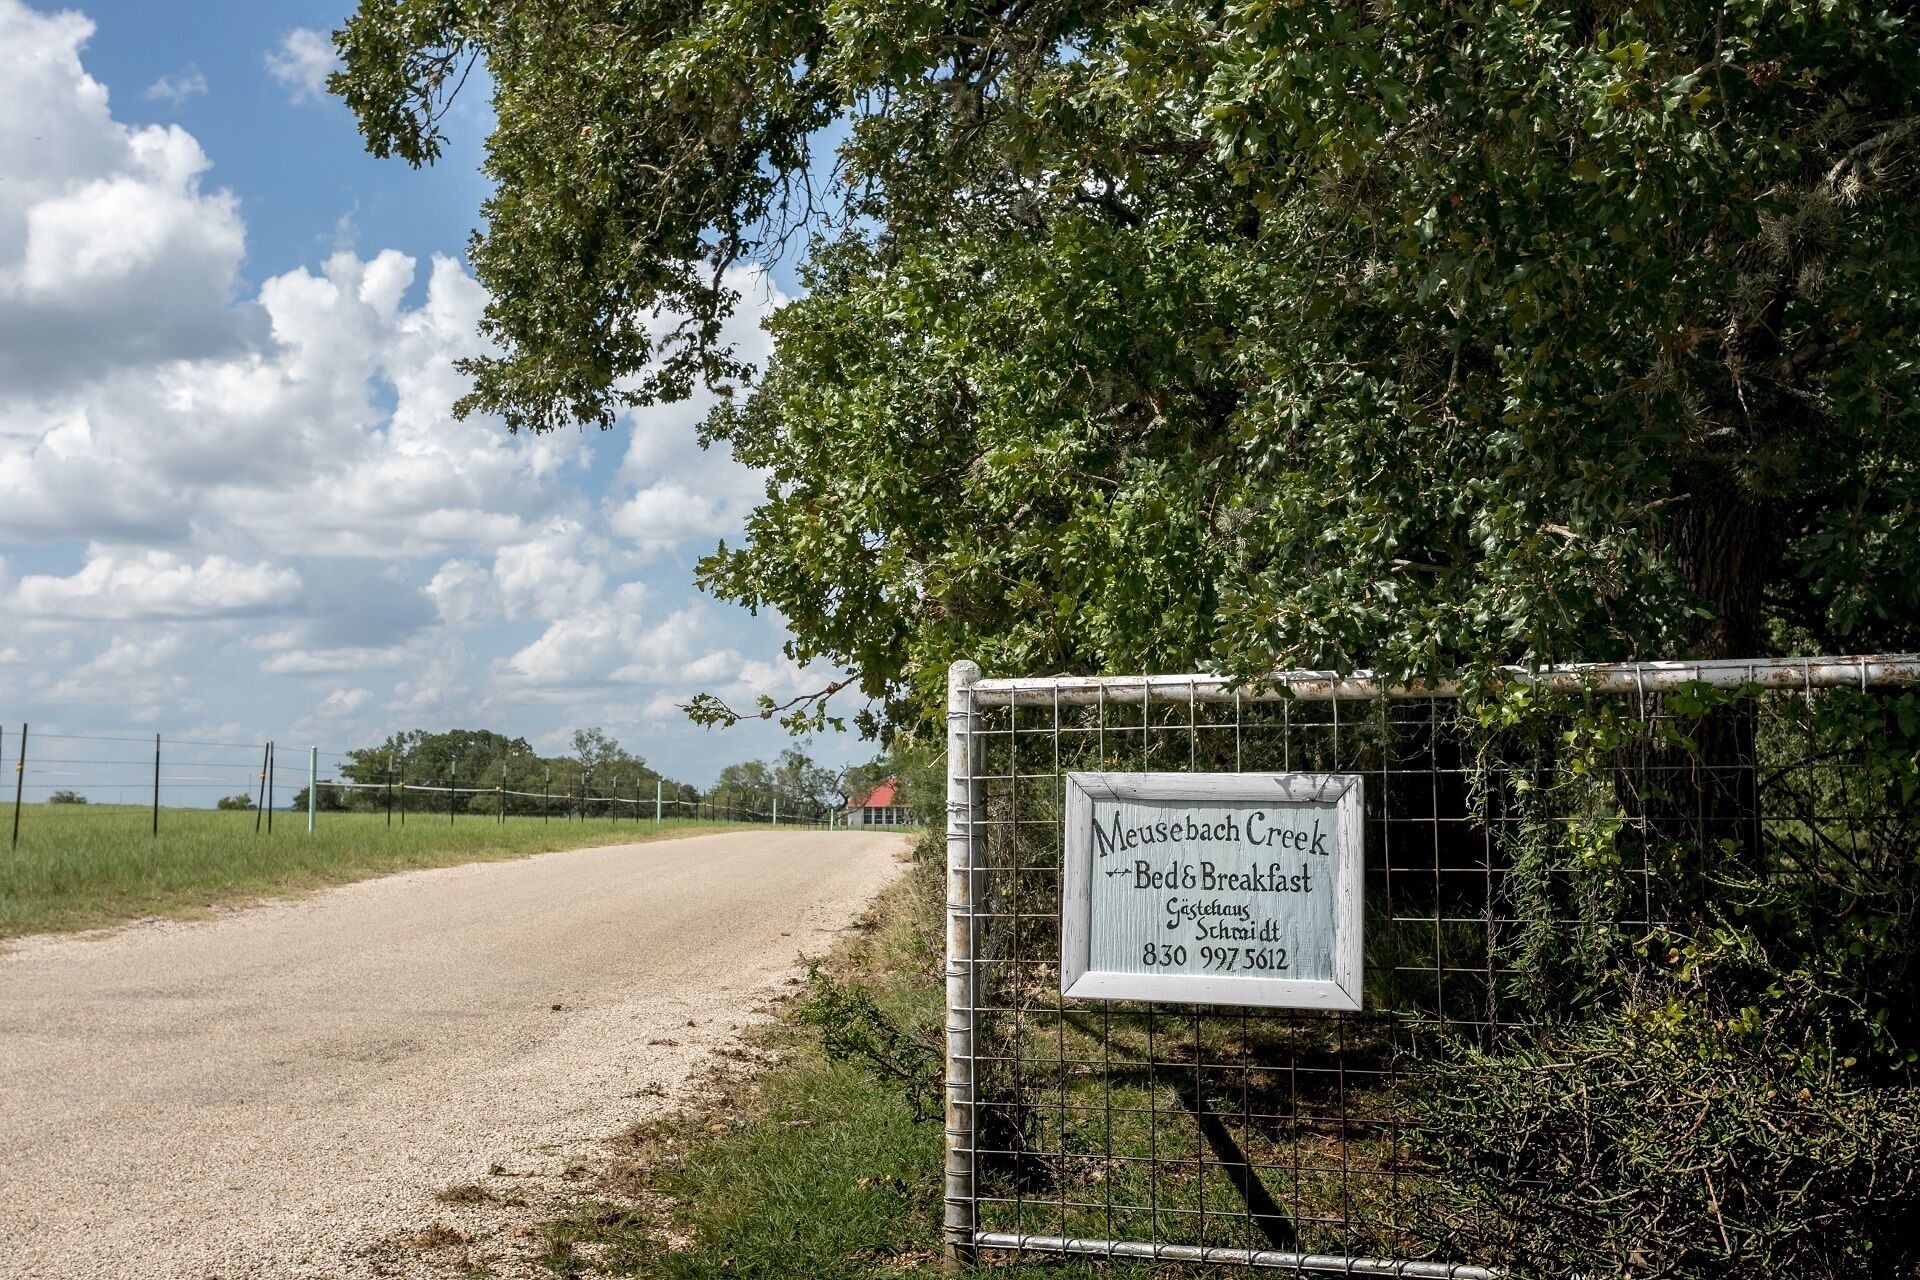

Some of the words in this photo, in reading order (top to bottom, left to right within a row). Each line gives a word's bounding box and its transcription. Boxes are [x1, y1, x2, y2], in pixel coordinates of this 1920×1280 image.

[1092, 810, 1241, 857] Meusebach
[1246, 811, 1329, 856] Creek
[1166, 897, 1250, 930] Gästehaus
[1195, 917, 1282, 942] Schmidt
[1142, 942, 1187, 967] 830
[1200, 946, 1239, 971] 997
[1243, 947, 1290, 971] 5612
